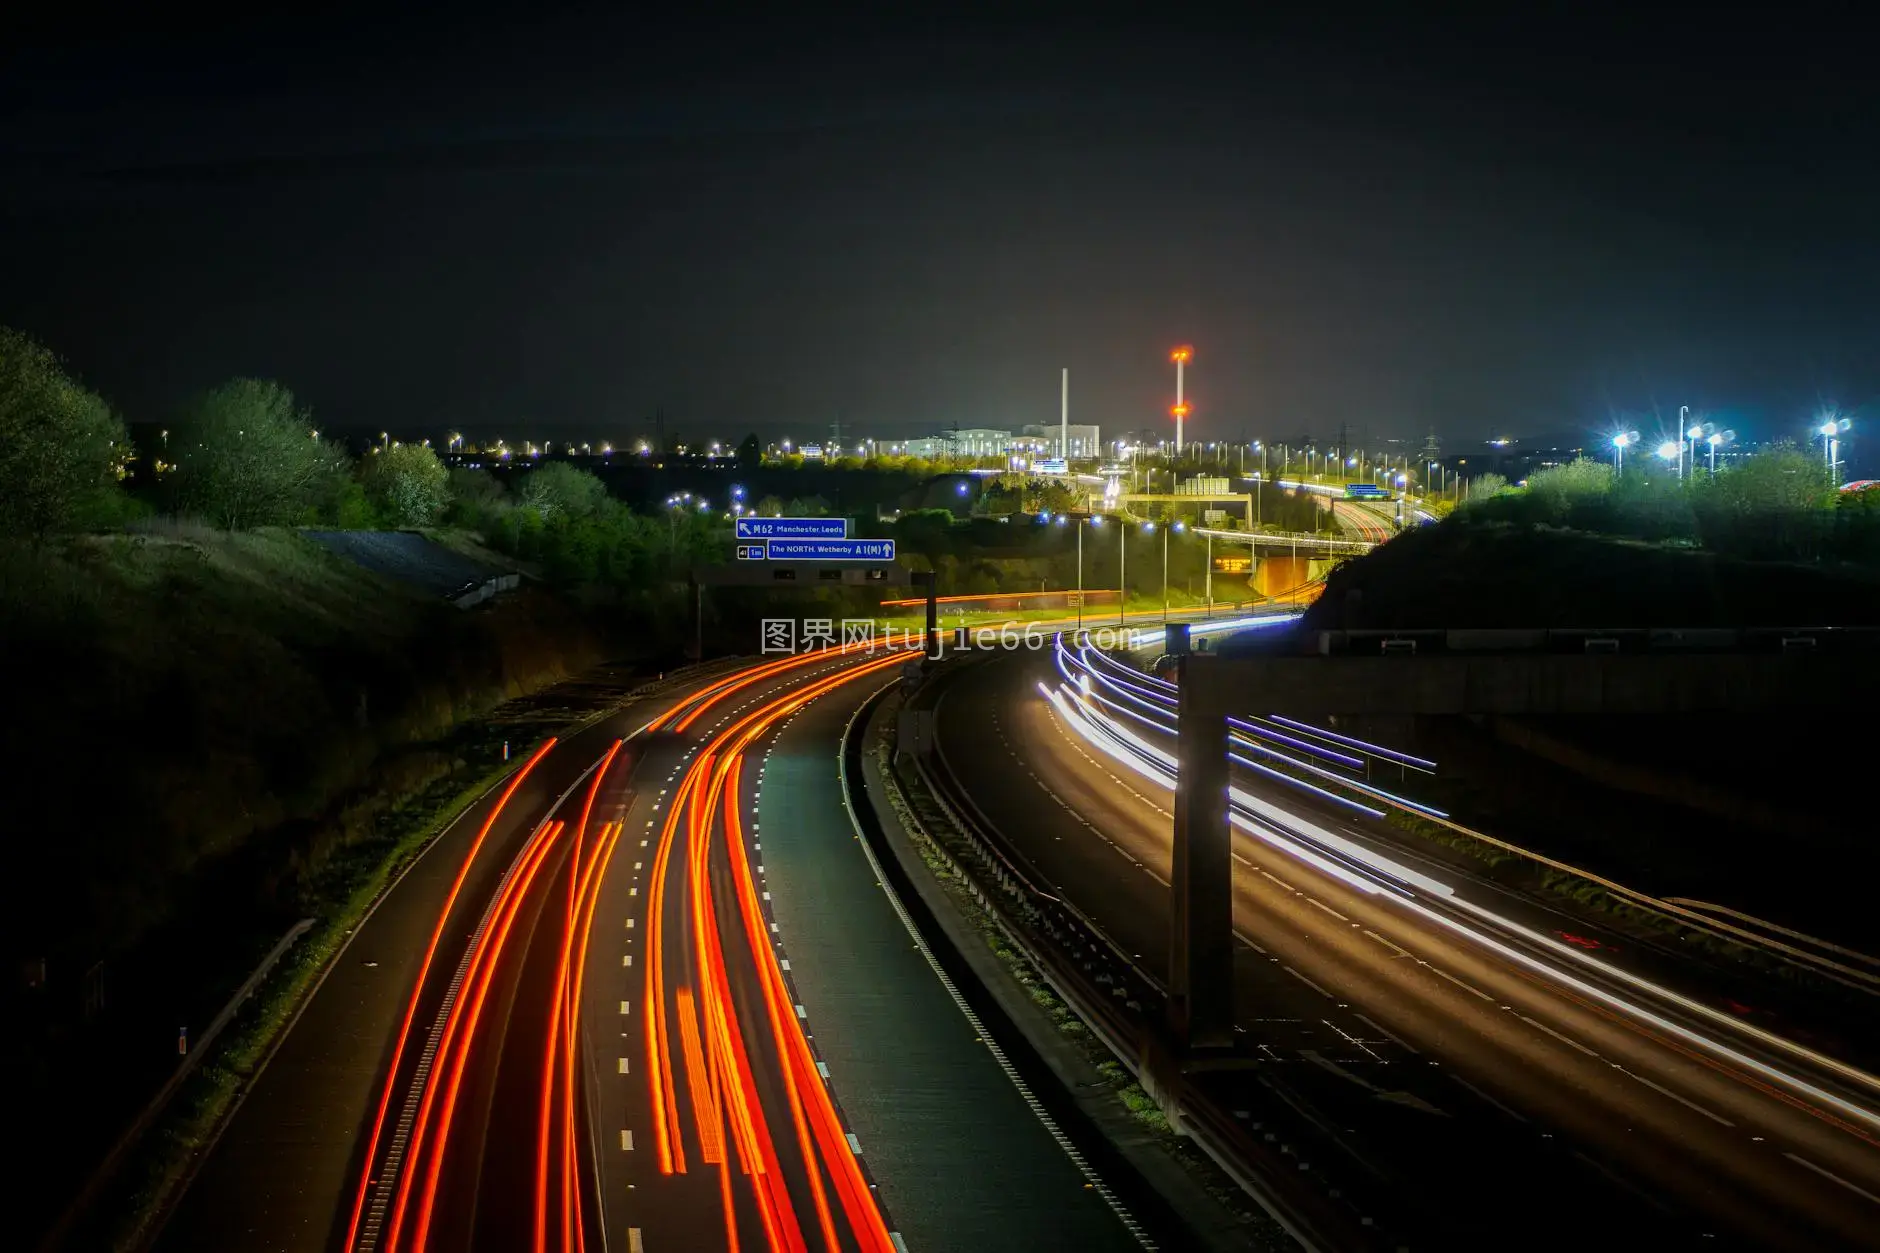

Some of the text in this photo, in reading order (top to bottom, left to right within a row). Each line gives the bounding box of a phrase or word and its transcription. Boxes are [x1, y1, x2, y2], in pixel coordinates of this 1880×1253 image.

[753, 525, 773, 534] M62
[821, 525, 843, 533] Leeds
[772, 545, 786, 553] The
[818, 545, 852, 554] Wetherby
